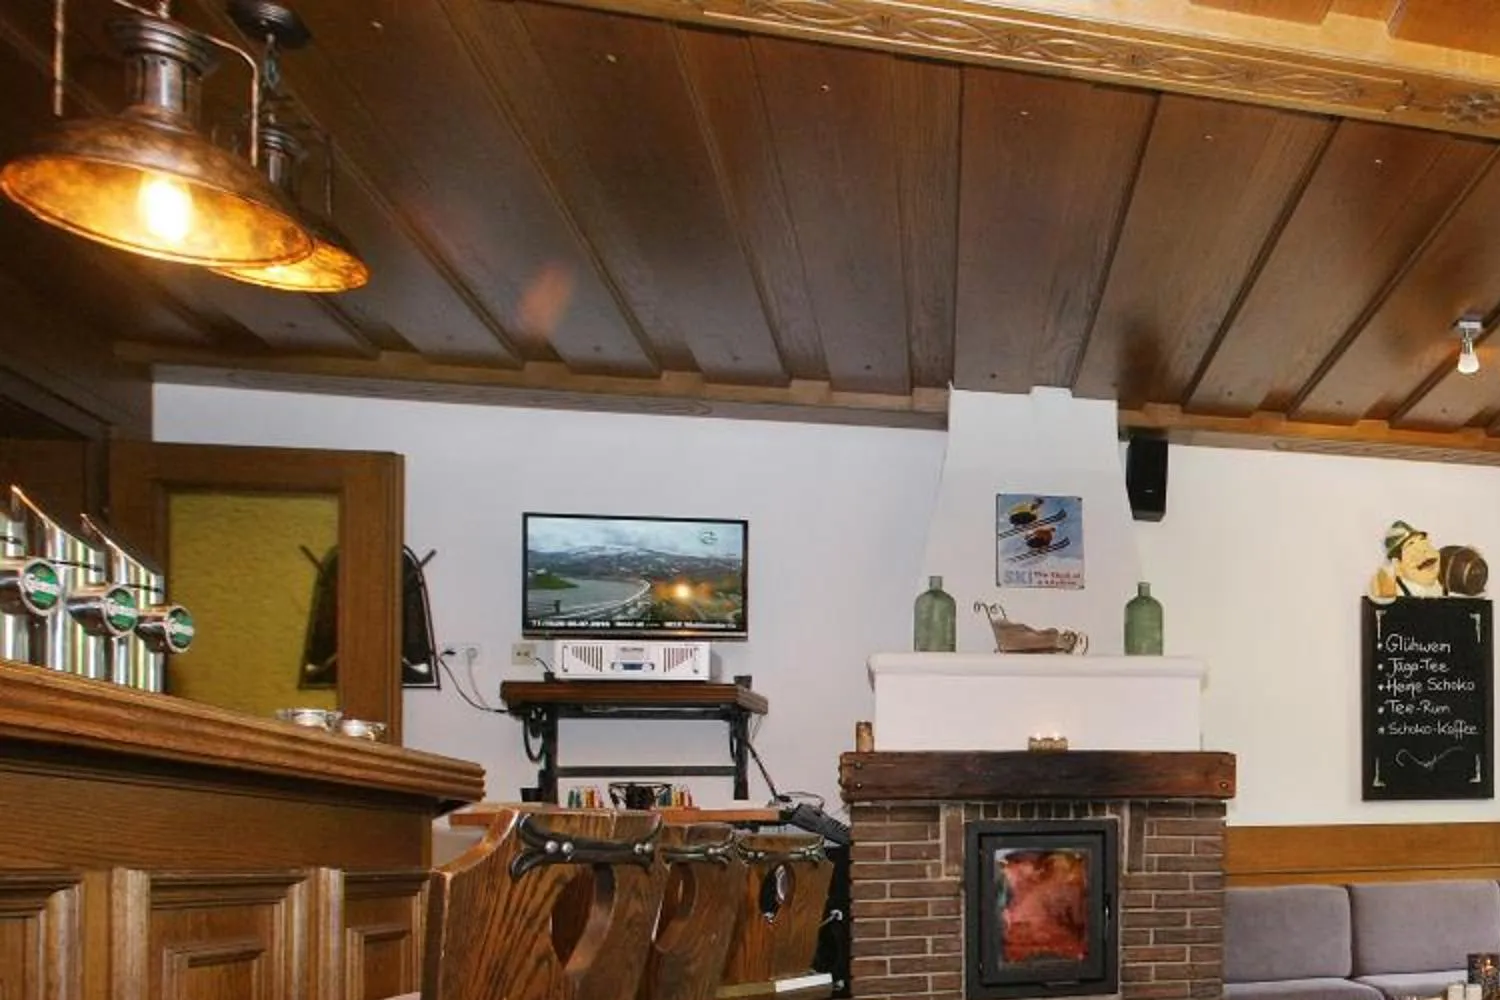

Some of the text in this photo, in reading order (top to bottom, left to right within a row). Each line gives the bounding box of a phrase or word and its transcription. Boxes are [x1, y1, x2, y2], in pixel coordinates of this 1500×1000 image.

[1004, 570, 1032, 584] SKI
[1427, 677, 1475, 692] Schoko
[1384, 699, 1450, 714] Tee-Rum
